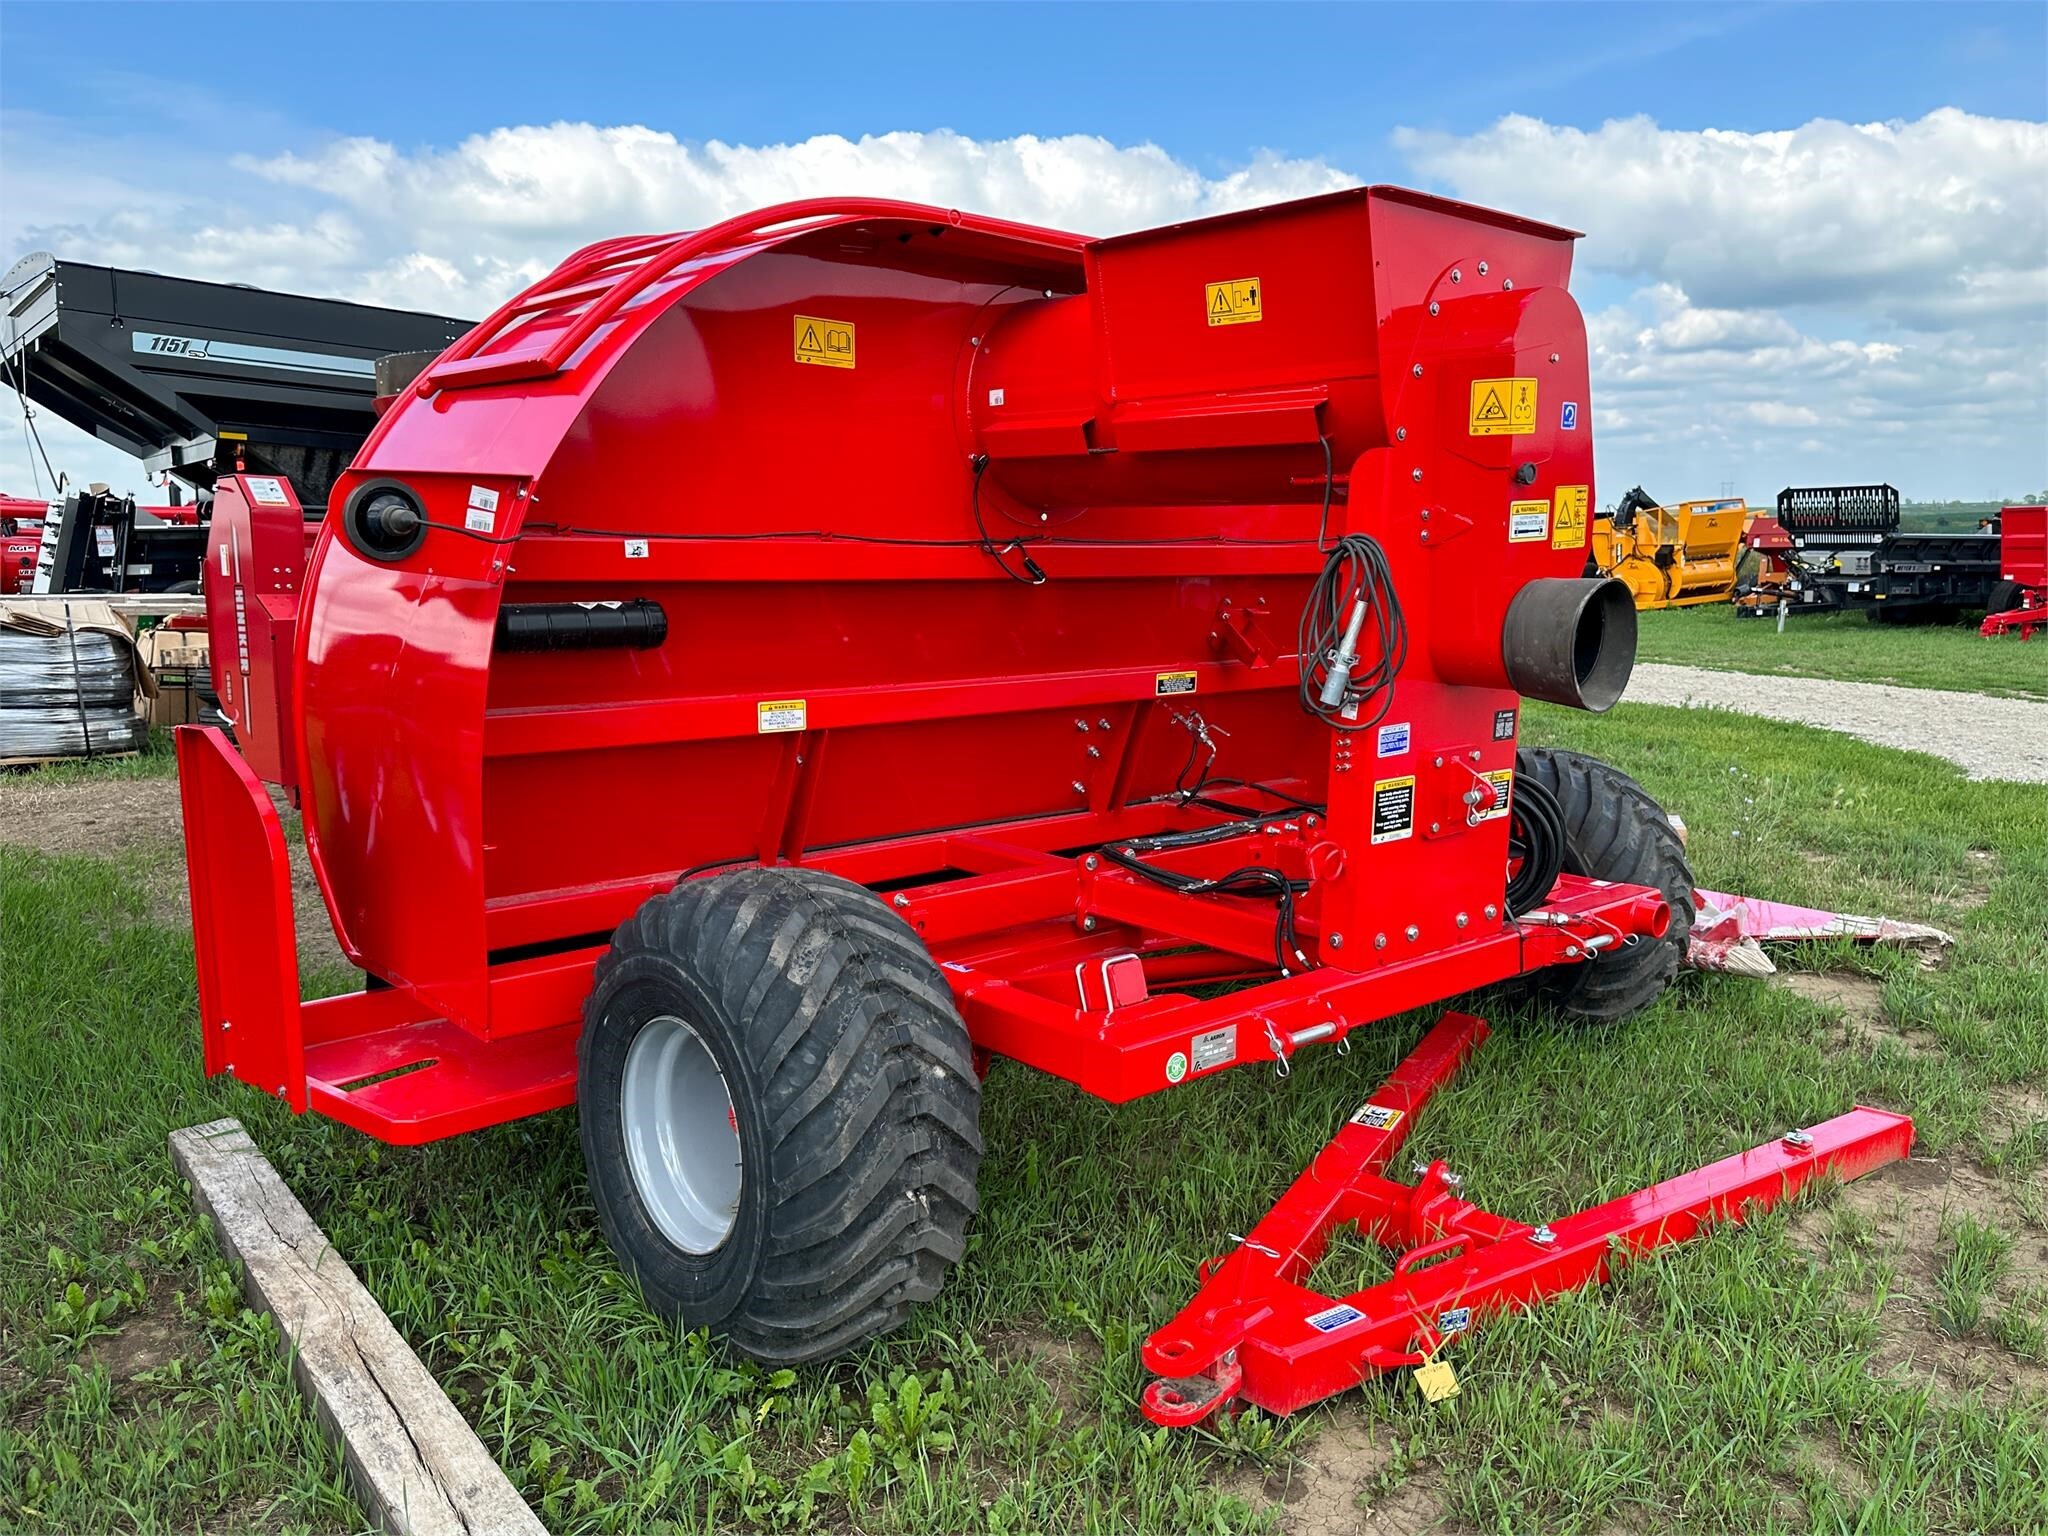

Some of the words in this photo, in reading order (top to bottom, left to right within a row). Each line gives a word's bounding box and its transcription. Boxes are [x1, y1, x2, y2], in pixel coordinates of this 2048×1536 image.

[151, 337, 190, 353] 1151
[235, 589, 249, 673] HINIKER
[1388, 780, 1408, 788] WARNING
[1209, 1033, 1226, 1041] AKRON
[1309, 1306, 1345, 1322] IMPORTANT
